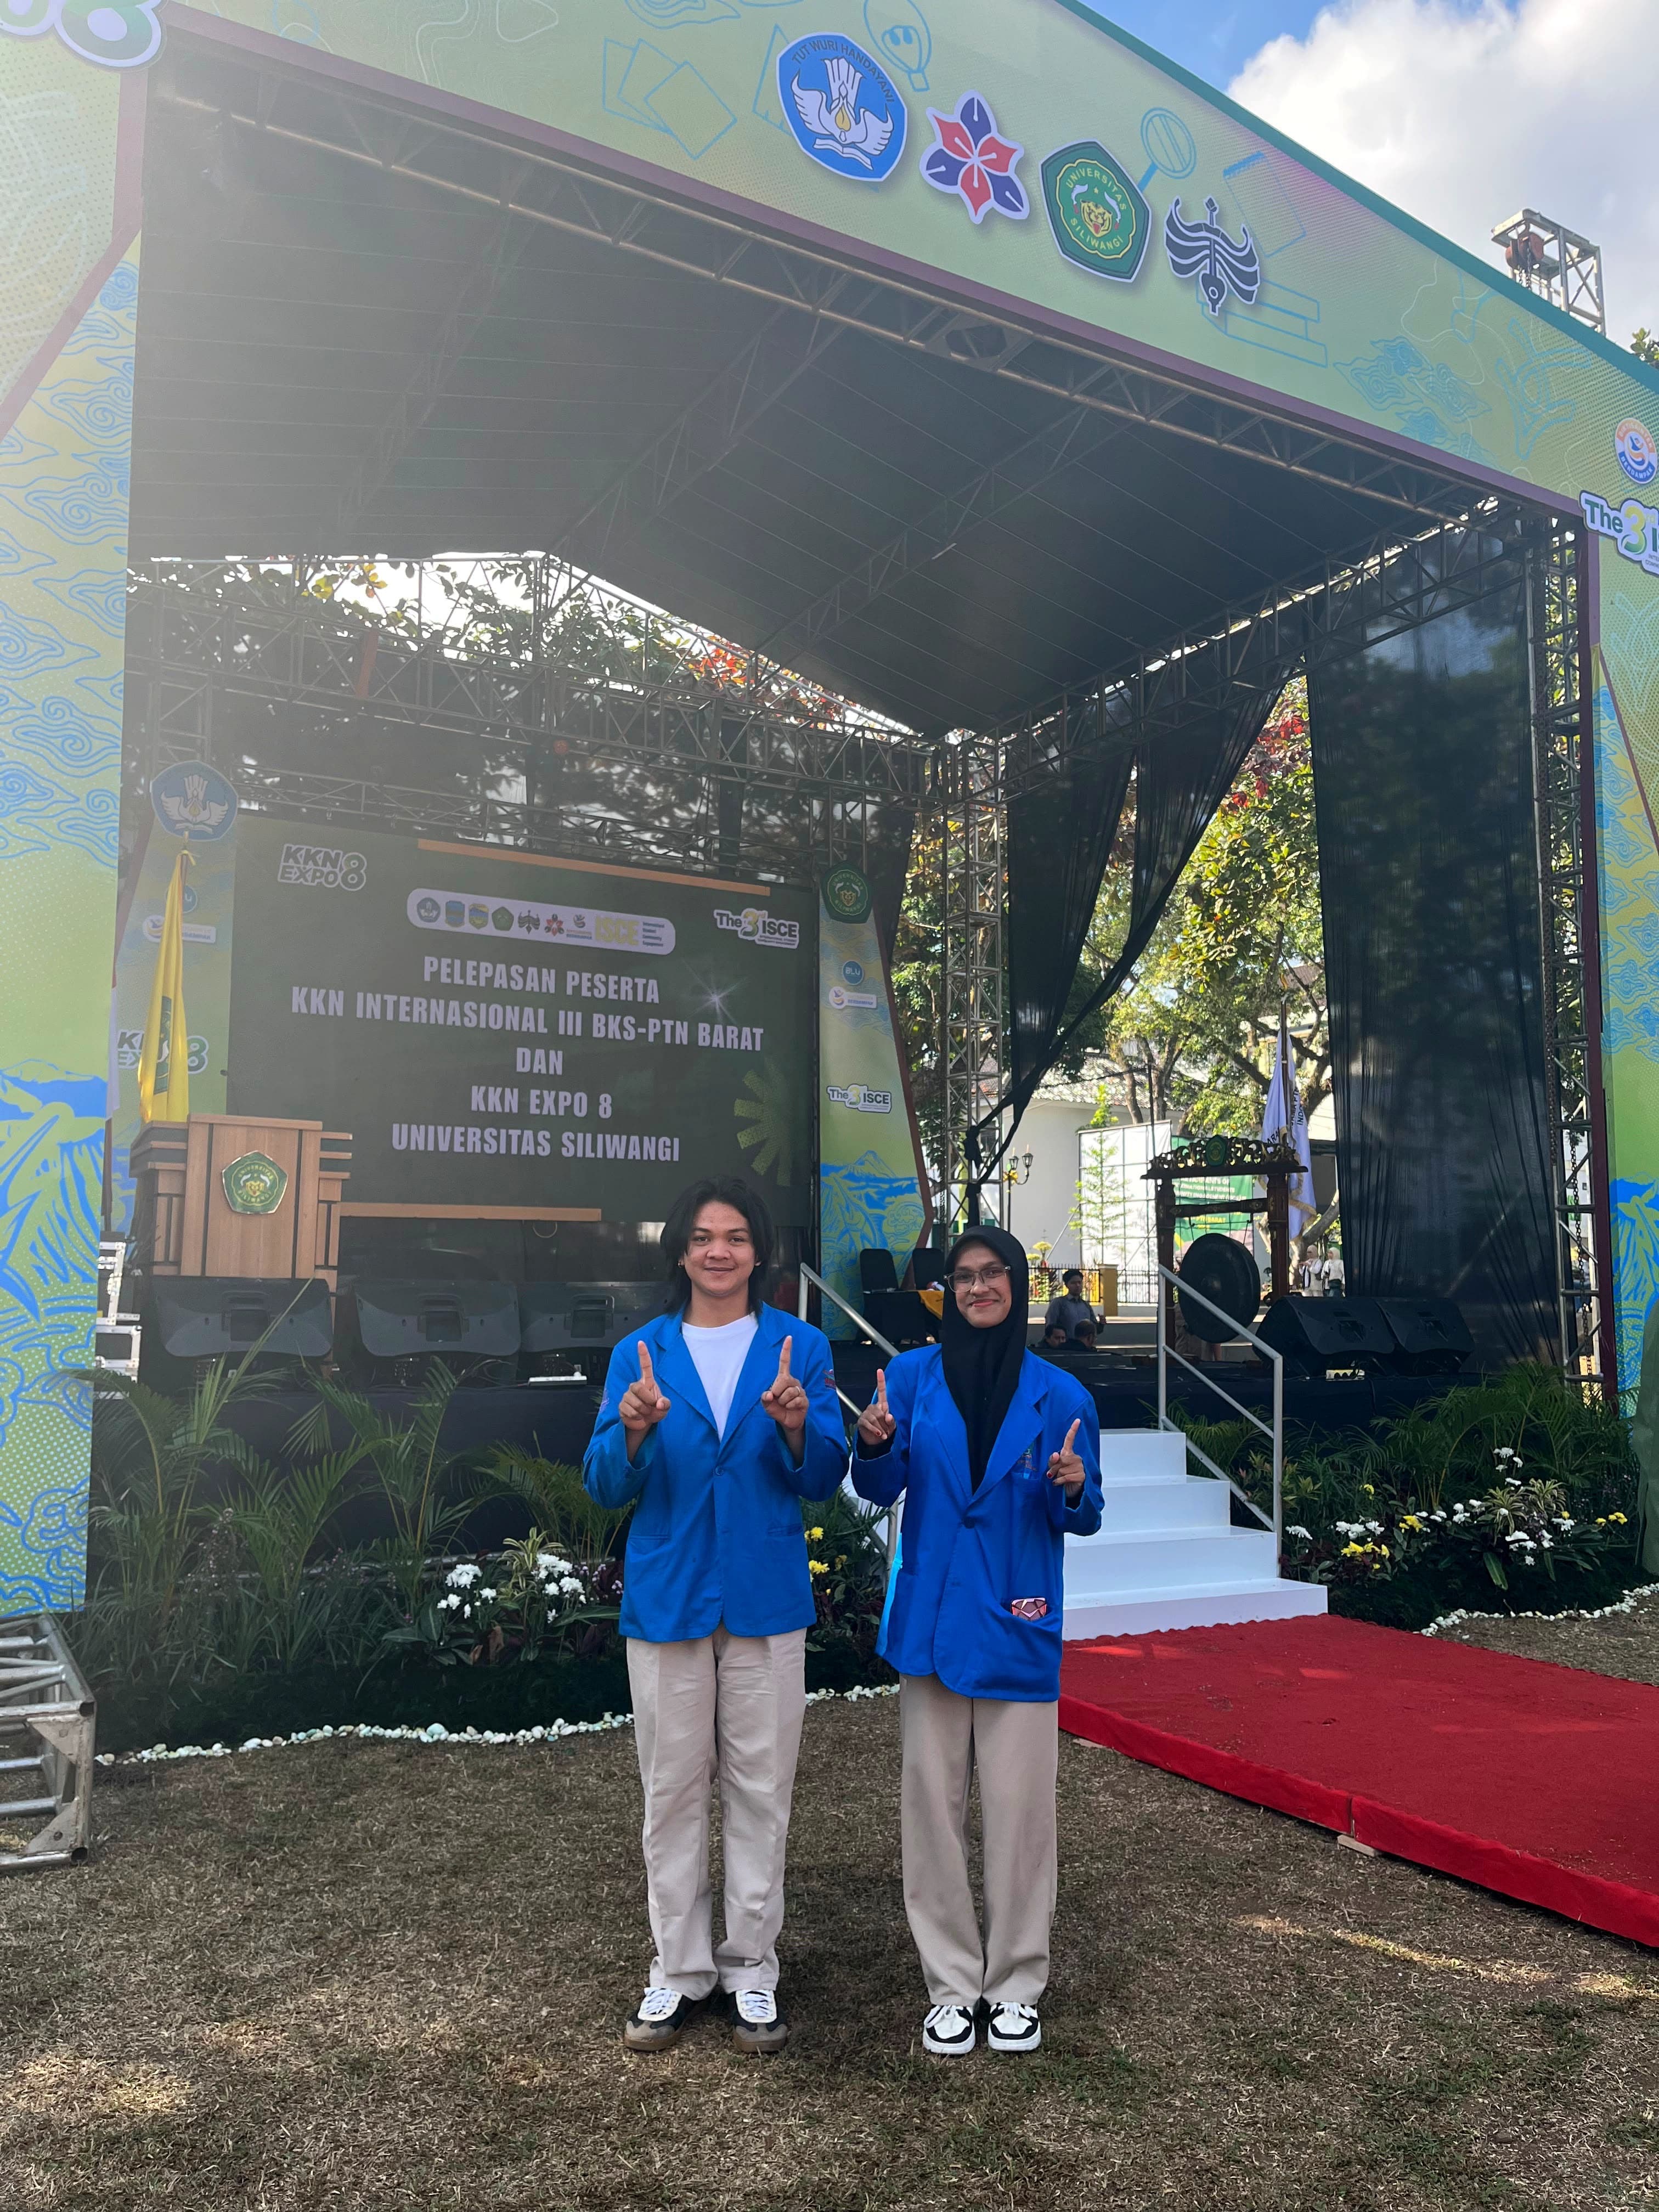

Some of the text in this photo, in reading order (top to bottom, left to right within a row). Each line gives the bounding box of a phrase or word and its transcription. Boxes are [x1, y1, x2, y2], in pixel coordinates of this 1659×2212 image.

[792, 40, 895, 103] TUT WURI HANDAYANI
[1066, 167, 1127, 210] UNIVERSITAS
[1070, 217, 1124, 250] SILIWANGI
[1620, 456, 1654, 479] BERDAMPAK
[1585, 498, 1623, 533] The
[283, 846, 342, 870] KKN
[280, 865, 339, 886] EXPO
[716, 912, 741, 928] The
[761, 921, 797, 938] ISCE
[424, 957, 659, 1003] PELEPASAN PESERTA
[292, 986, 764, 1051] KKN INTERNASIONAL III BKS-PTN BARAT
[516, 1047, 563, 1075] DAN
[471, 1085, 612, 1119] KKN EXPO 8
[829, 1088, 849, 1099] The
[863, 1093, 889, 1104] ISCE
[392, 1123, 679, 1161] UNIVERSITAS SILIWANGI
